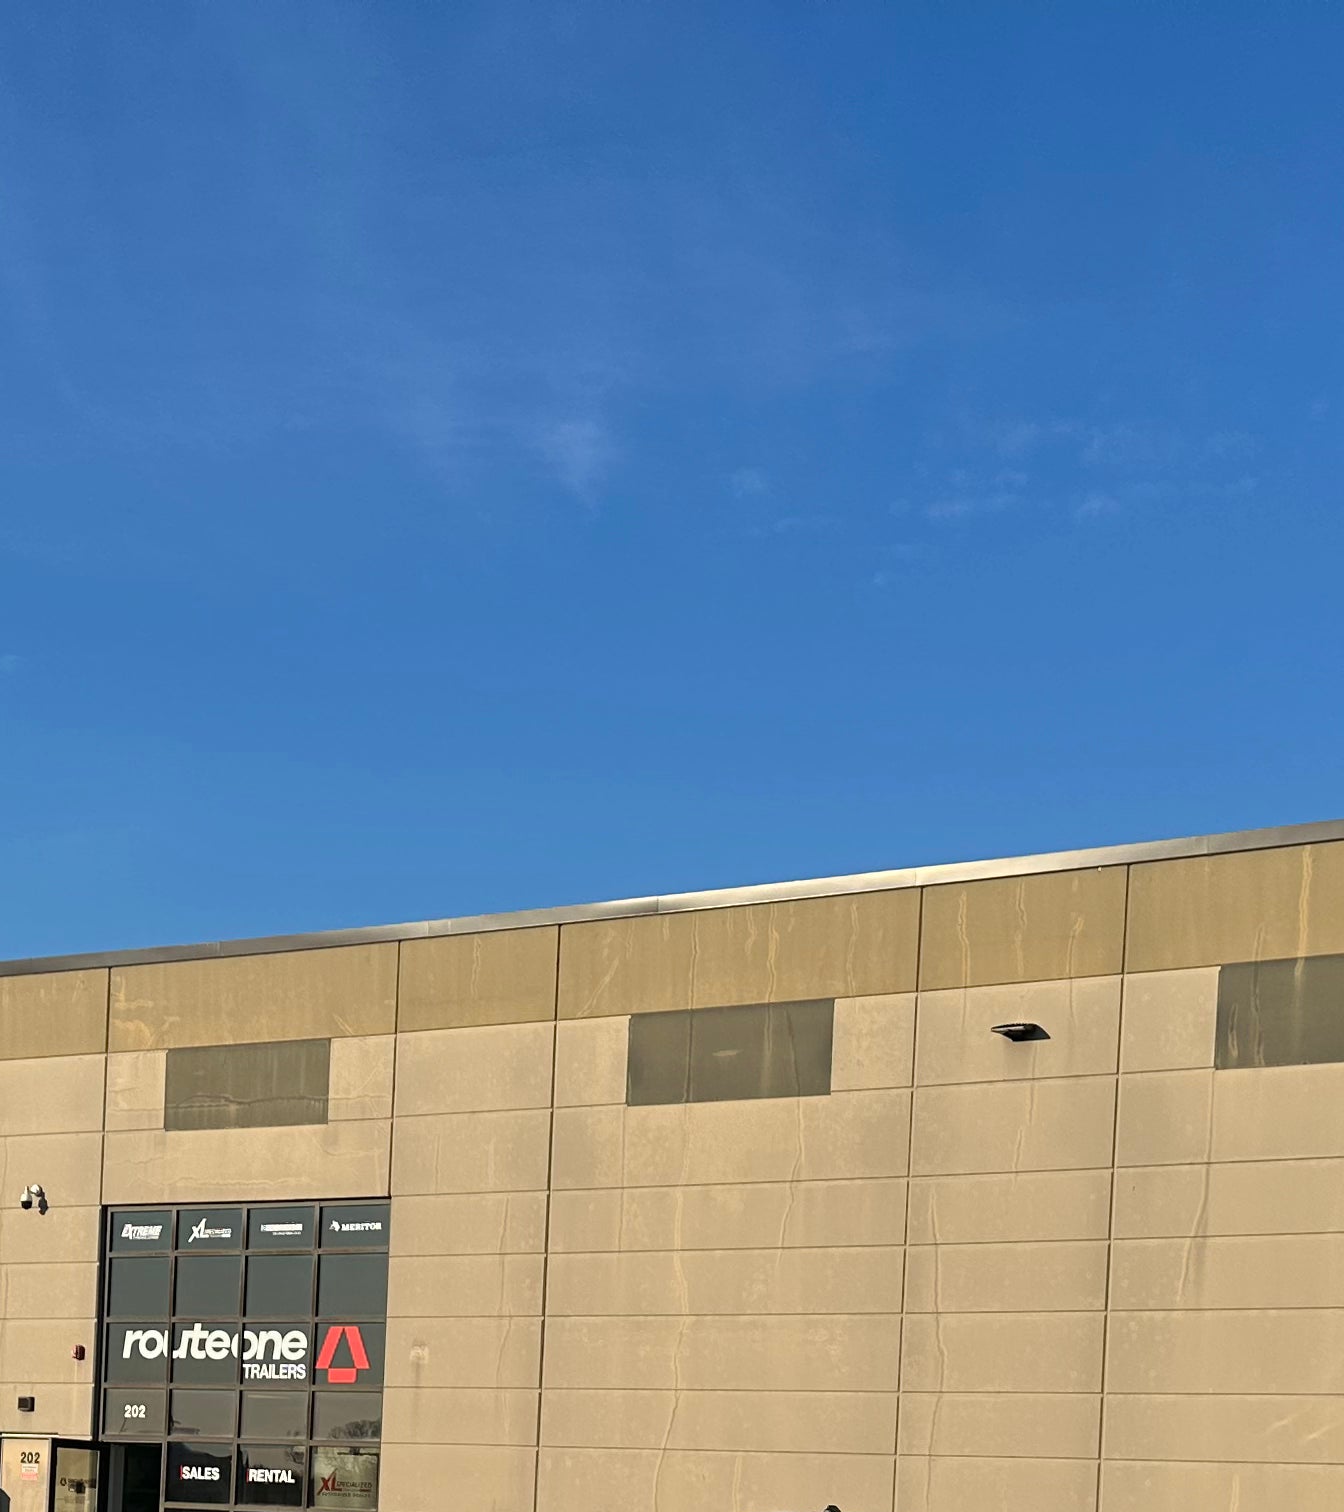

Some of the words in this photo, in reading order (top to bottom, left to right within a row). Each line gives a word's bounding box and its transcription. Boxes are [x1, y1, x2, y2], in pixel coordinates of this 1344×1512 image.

[122, 1323, 308, 1361] routeone
[244, 1364, 306, 1380] TRAILERS
[124, 1404, 146, 1418] 202
[20, 1452, 40, 1464] 202
[181, 1465, 220, 1480] SALES
[248, 1467, 296, 1483] RENTAL
